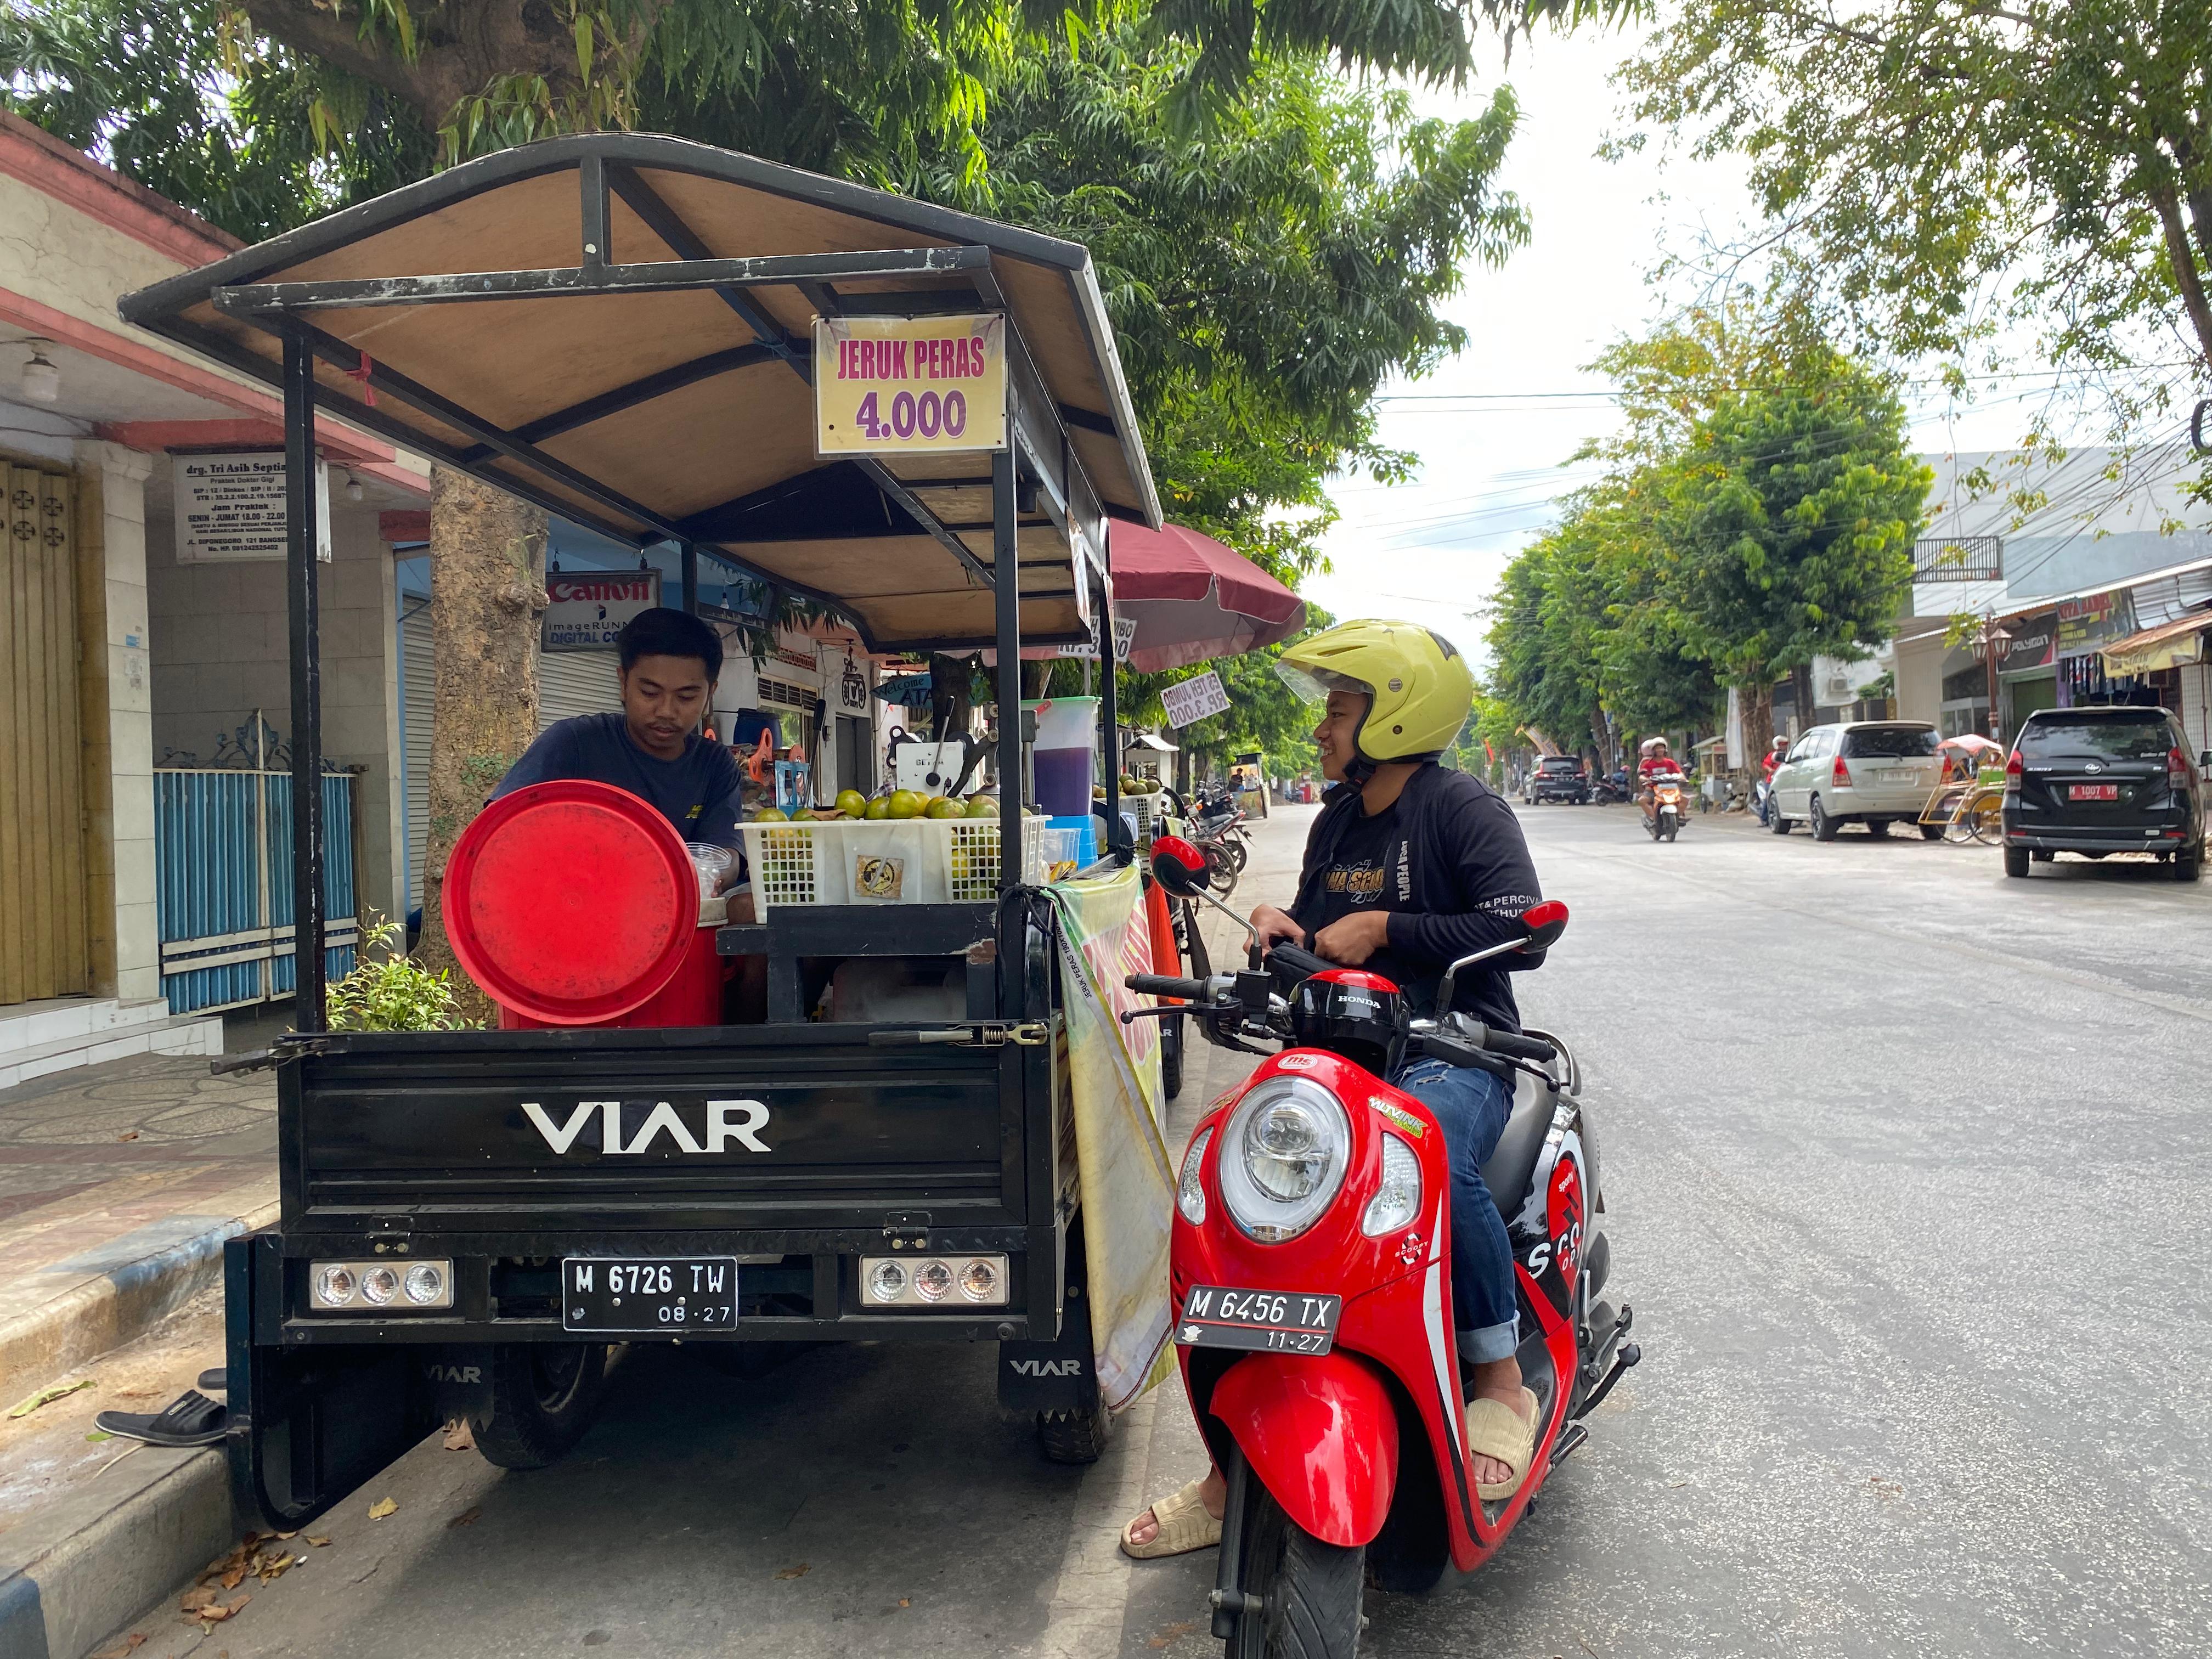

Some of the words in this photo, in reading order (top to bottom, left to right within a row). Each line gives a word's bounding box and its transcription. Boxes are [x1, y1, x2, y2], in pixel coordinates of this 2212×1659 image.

[838, 340, 908, 380] JERUK
[914, 337, 985, 379] PERAS
[856, 390, 967, 438] 4.000
[187, 465, 207, 476] drg.
[210, 464, 224, 472] Tri
[227, 464, 250, 472] Asih
[549, 582, 649, 602] Canon
[550, 632, 599, 644] DIGITAL
[873, 677, 924, 696] Welcome
[2081, 786, 2101, 795] 1007
[1397, 864, 1410, 902] PEOPLE
[1066, 955, 1082, 979] PERAS
[1078, 979, 1092, 998] JERUK
[1338, 996, 1381, 1008] HONDA
[521, 1100, 771, 1154] VIAR
[1395, 1241, 1429, 1257] SCOOPY
[576, 1265, 593, 1293] M
[608, 1265, 673, 1294] 6726
[690, 1265, 725, 1293] TW
[1188, 1290, 1212, 1317] M
[1219, 1292, 1287, 1323] 6456
[1300, 1297, 1332, 1328] TX
[1009, 1359, 1082, 1376] VIAR
